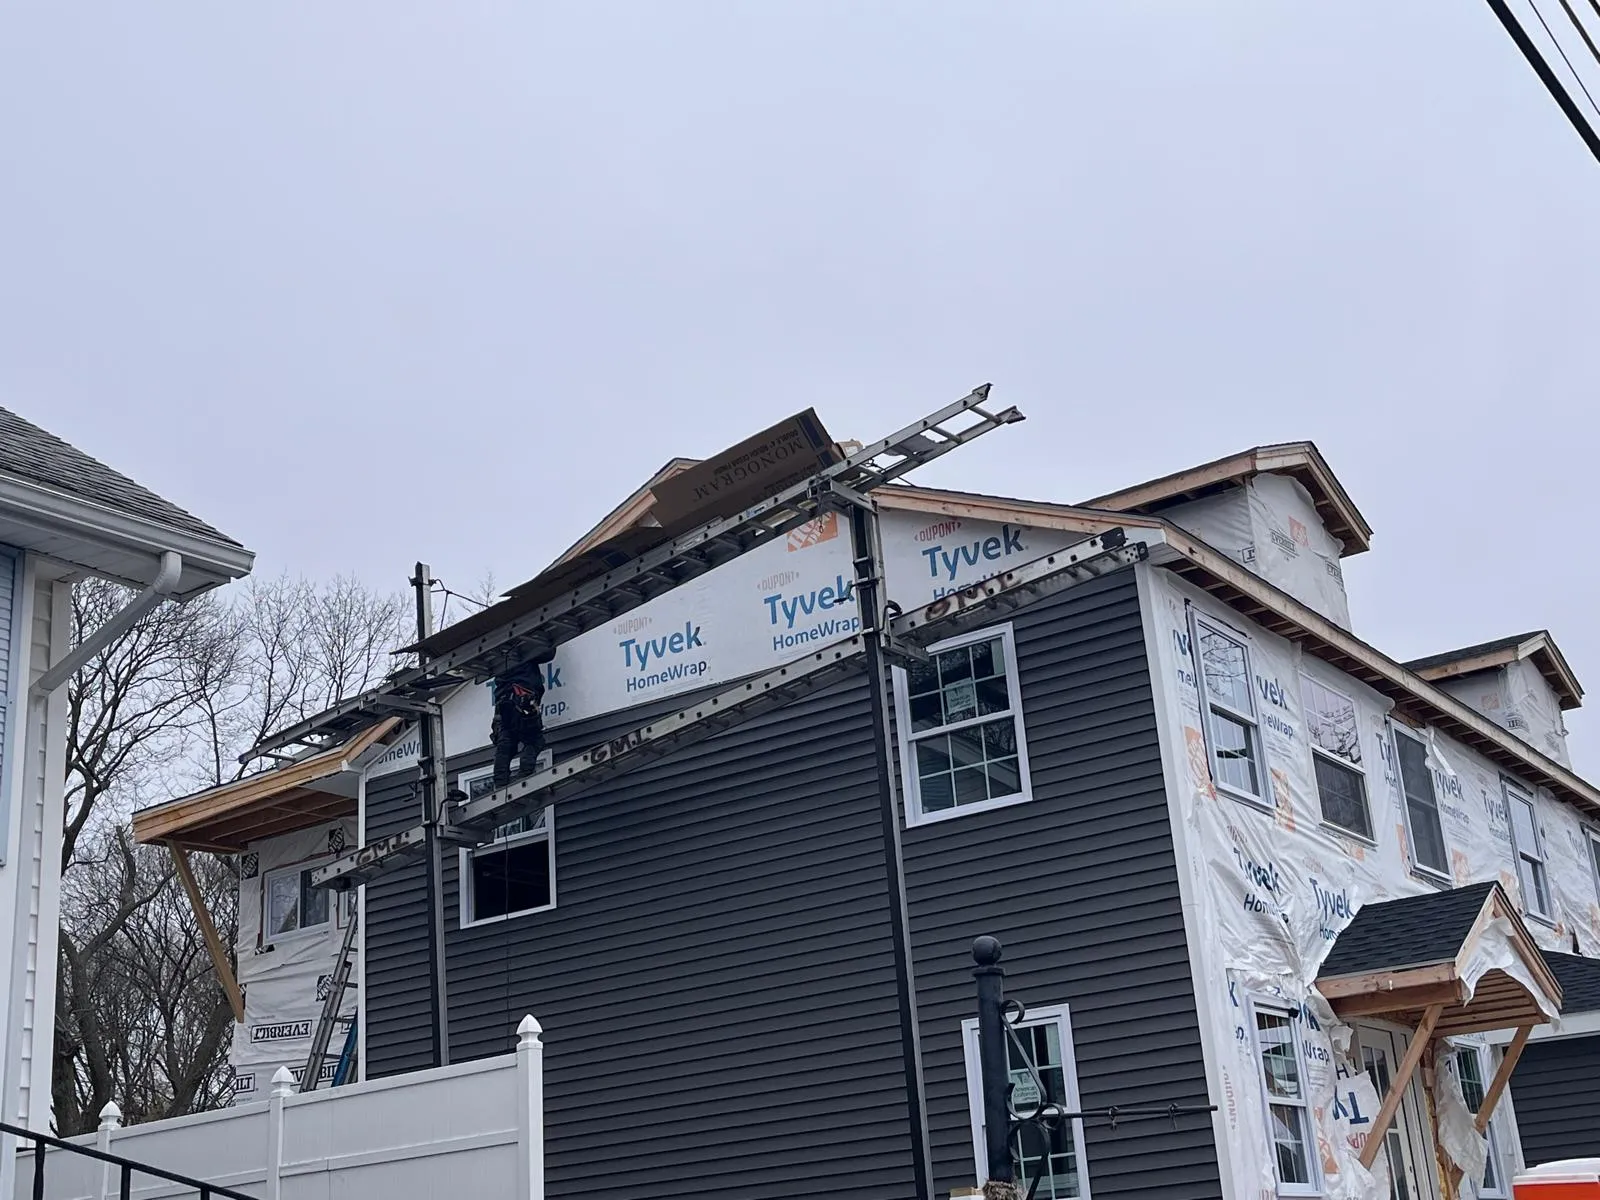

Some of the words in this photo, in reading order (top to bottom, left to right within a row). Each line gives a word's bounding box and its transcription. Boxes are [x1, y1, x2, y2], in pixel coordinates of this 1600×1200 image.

[696, 439, 804, 500] MONOGRAM
[920, 521, 956, 542] DUPONT
[922, 524, 1024, 581] Tyvek
[762, 572, 795, 591] DUPONT
[764, 575, 855, 629] Tyvek
[618, 617, 649, 635] DUPONT
[773, 616, 860, 651] HomeWrap
[619, 621, 703, 671] Tyvek
[627, 660, 707, 693] HomeWrap
[1309, 877, 1355, 920] Tyvek
[253, 1023, 310, 1041] EVERBILT
